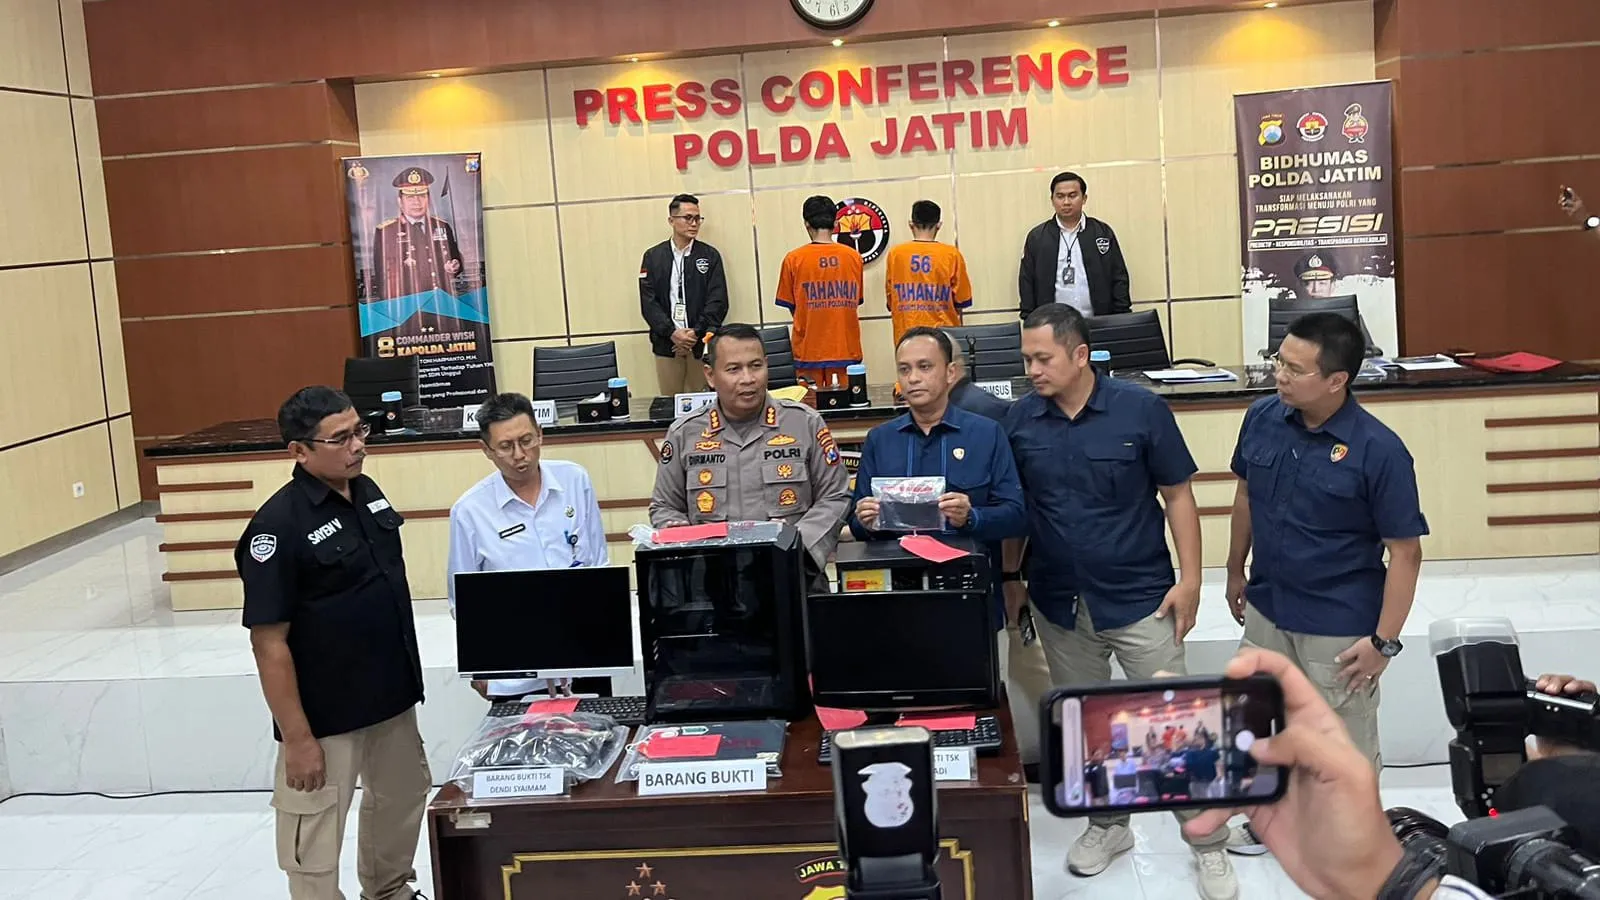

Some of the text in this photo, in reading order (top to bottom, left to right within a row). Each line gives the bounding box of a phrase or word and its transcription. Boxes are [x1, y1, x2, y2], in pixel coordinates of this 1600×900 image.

[574, 45, 1130, 127] PRESS CONFERENCE
[674, 107, 1029, 172] POLDA JATIM
[1260, 149, 1369, 171] BIDHUMAS
[1248, 166, 1382, 189] POLDA JATIM
[1255, 198, 1377, 213] TRANSFORMASI MENUJU POLRI YANG
[1279, 191, 1352, 203] SIAP MELAKSANAKAN
[1251, 213, 1384, 238] PRESISI
[818, 255, 839, 269] 80
[909, 254, 932, 273] 56
[802, 279, 858, 301] TAHANAN
[894, 282, 951, 303] TAHANAN
[395, 331, 475, 344] COMMANDER WISH
[377, 337, 394, 358] 8
[396, 342, 476, 357] KAPOLDA JATIM
[764, 447, 801, 460] POLRI
[307, 517, 343, 545] SAYEN V
[945, 753, 960, 762] TSK
[486, 772, 552, 782] BARANG BUKTI TSK
[645, 769, 754, 787] BARANG BUKTI
[489, 786, 512, 794] DENDI
[799, 861, 834, 878] JAWA
